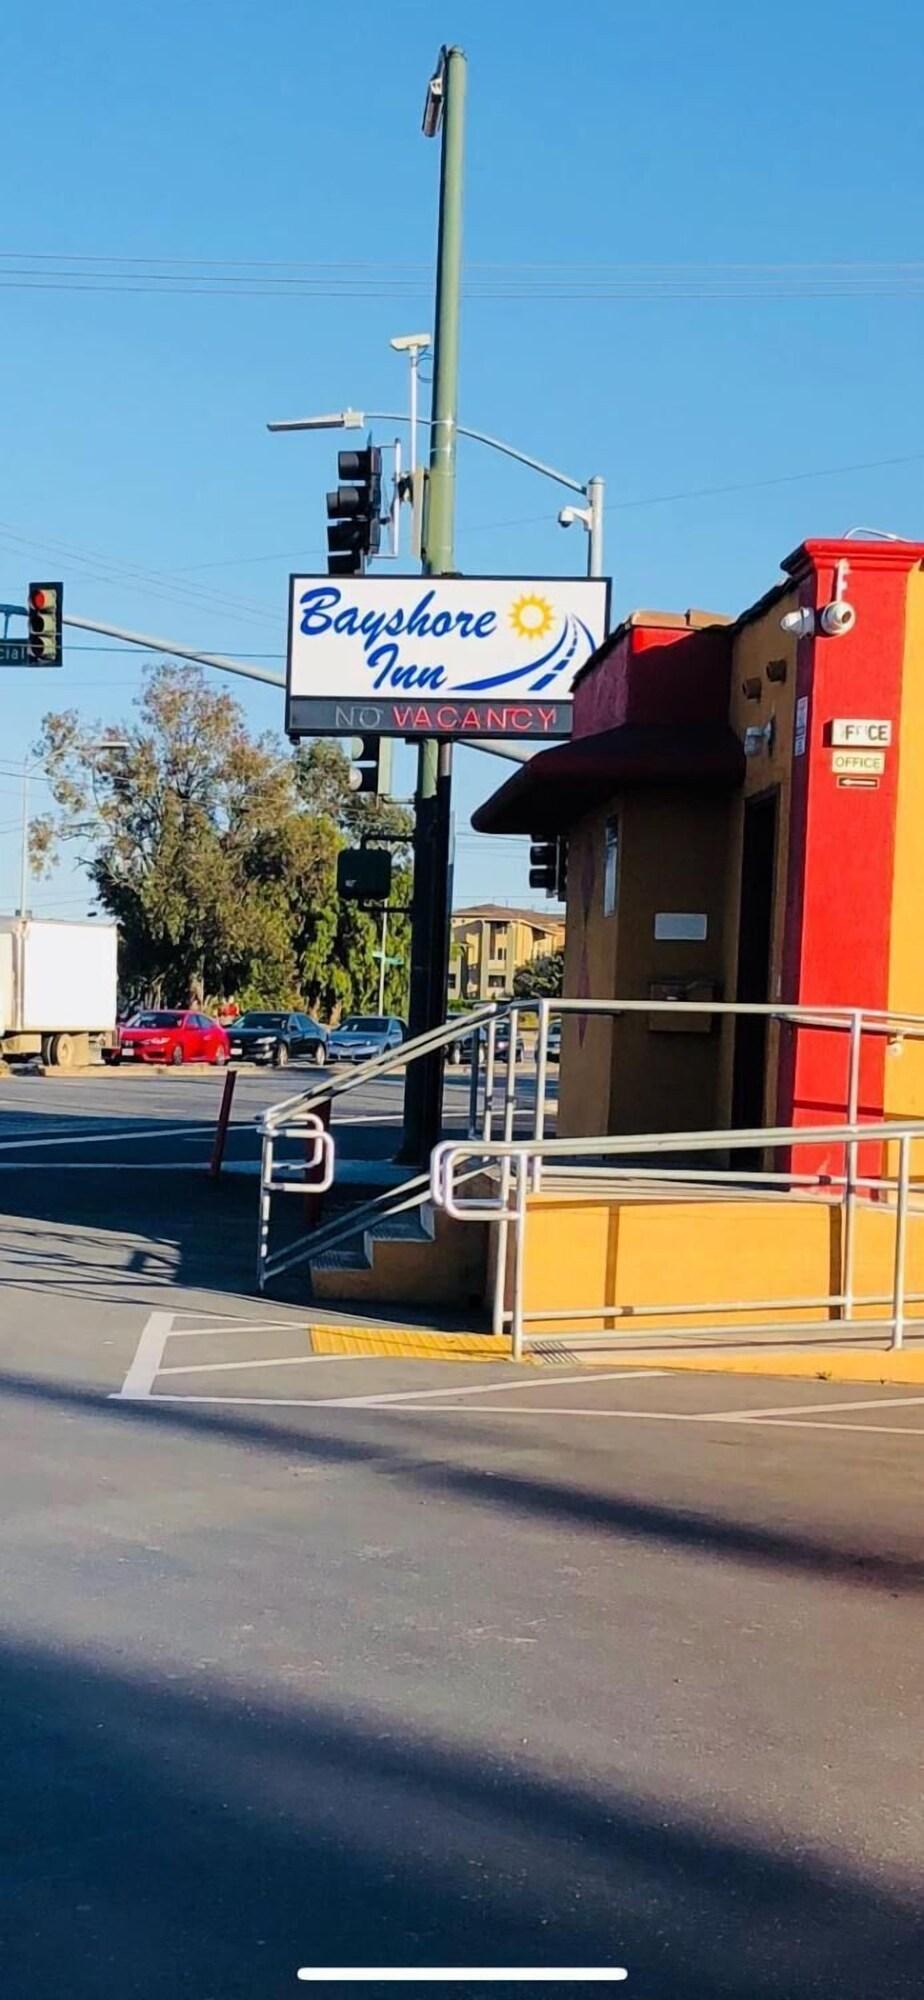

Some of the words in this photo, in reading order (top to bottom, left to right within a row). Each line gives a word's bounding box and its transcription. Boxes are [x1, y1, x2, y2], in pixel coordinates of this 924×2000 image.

[299, 586, 496, 650] Bayshore
[366, 643, 447, 690] Inn
[335, 706, 382, 729] NO
[393, 705, 557, 731] VACANCY
[835, 756, 881, 769] OFFICE
